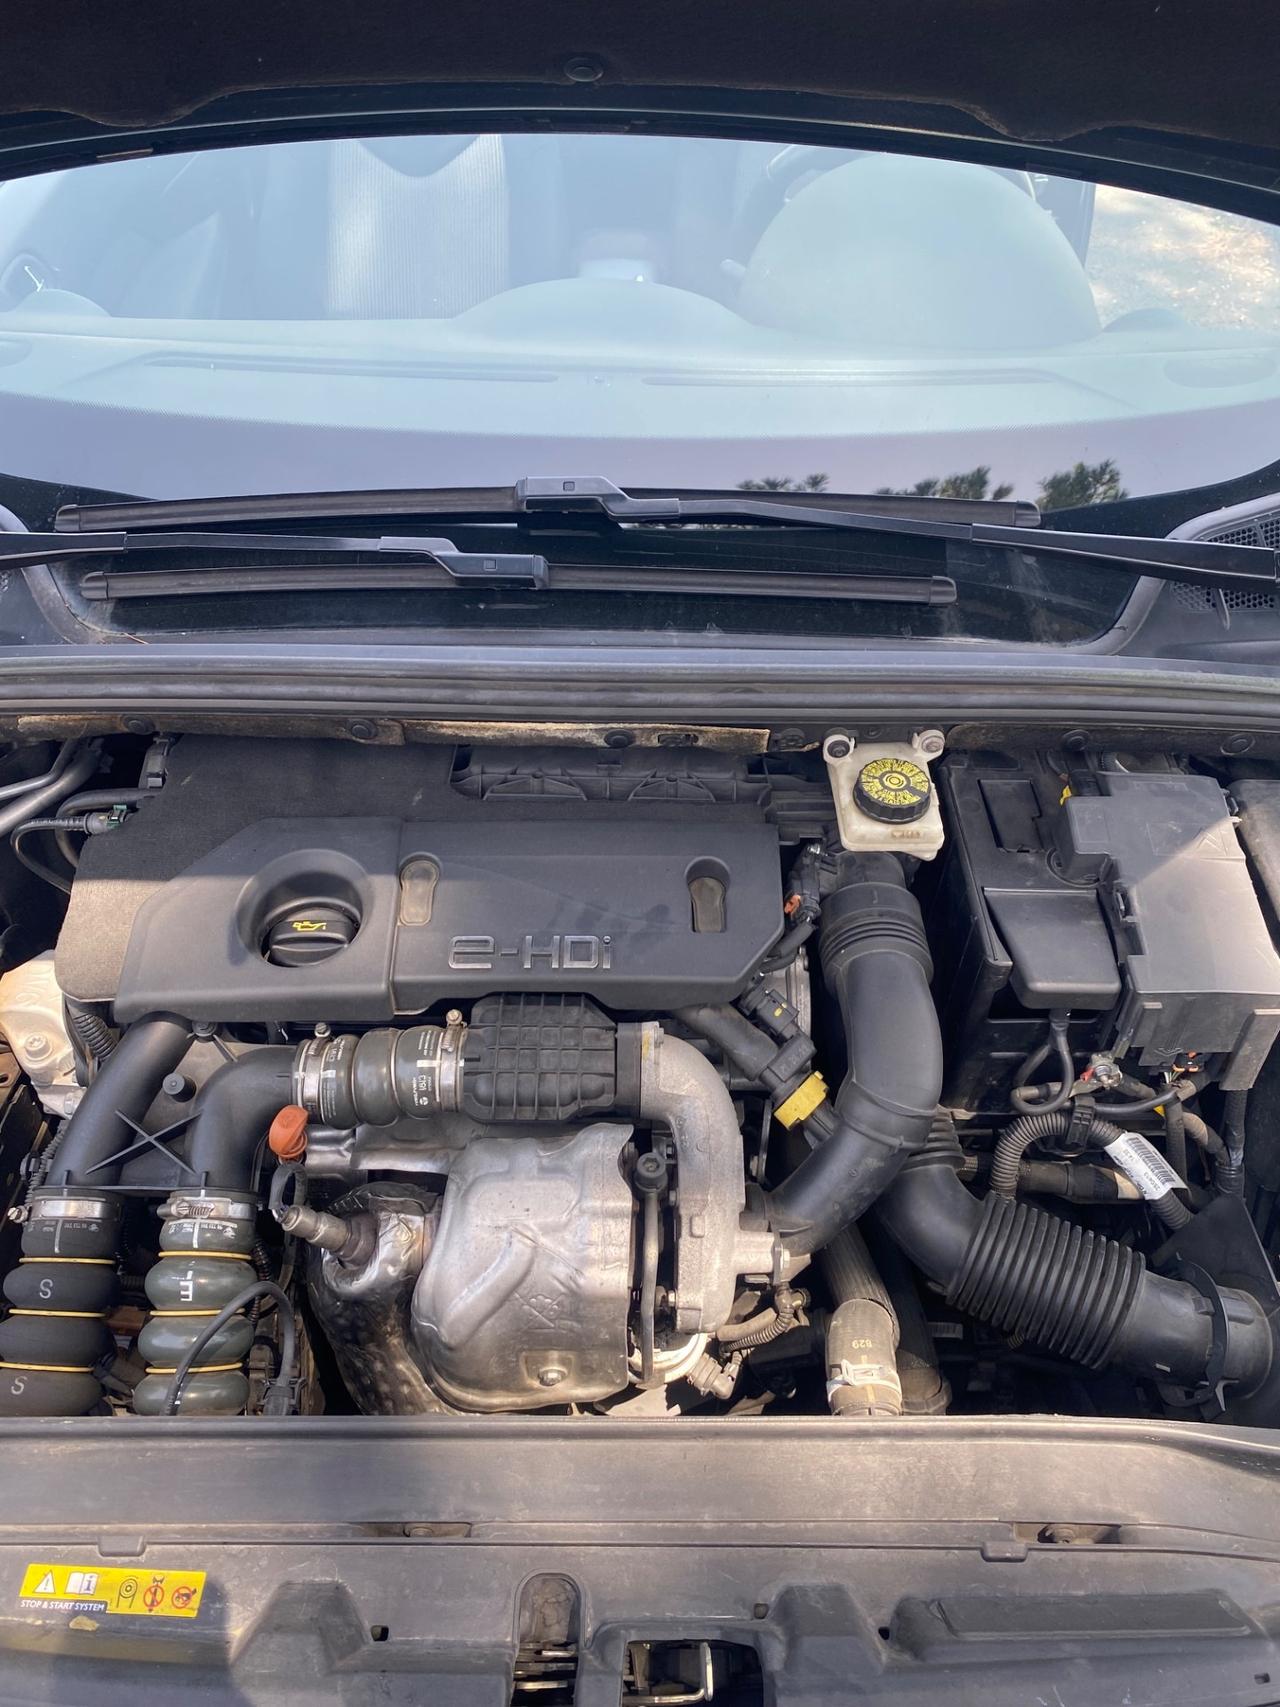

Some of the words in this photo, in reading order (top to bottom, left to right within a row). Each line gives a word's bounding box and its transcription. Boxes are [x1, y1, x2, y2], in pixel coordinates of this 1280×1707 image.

[448, 935, 612, 969] e-HDi
[39, 1279, 53, 1298] S
[10, 1375, 28, 1395] S
[20, 1600, 42, 1608] STOP
[49, 1602, 74, 1610] START
[74, 1602, 105, 1611] SYSTEM
